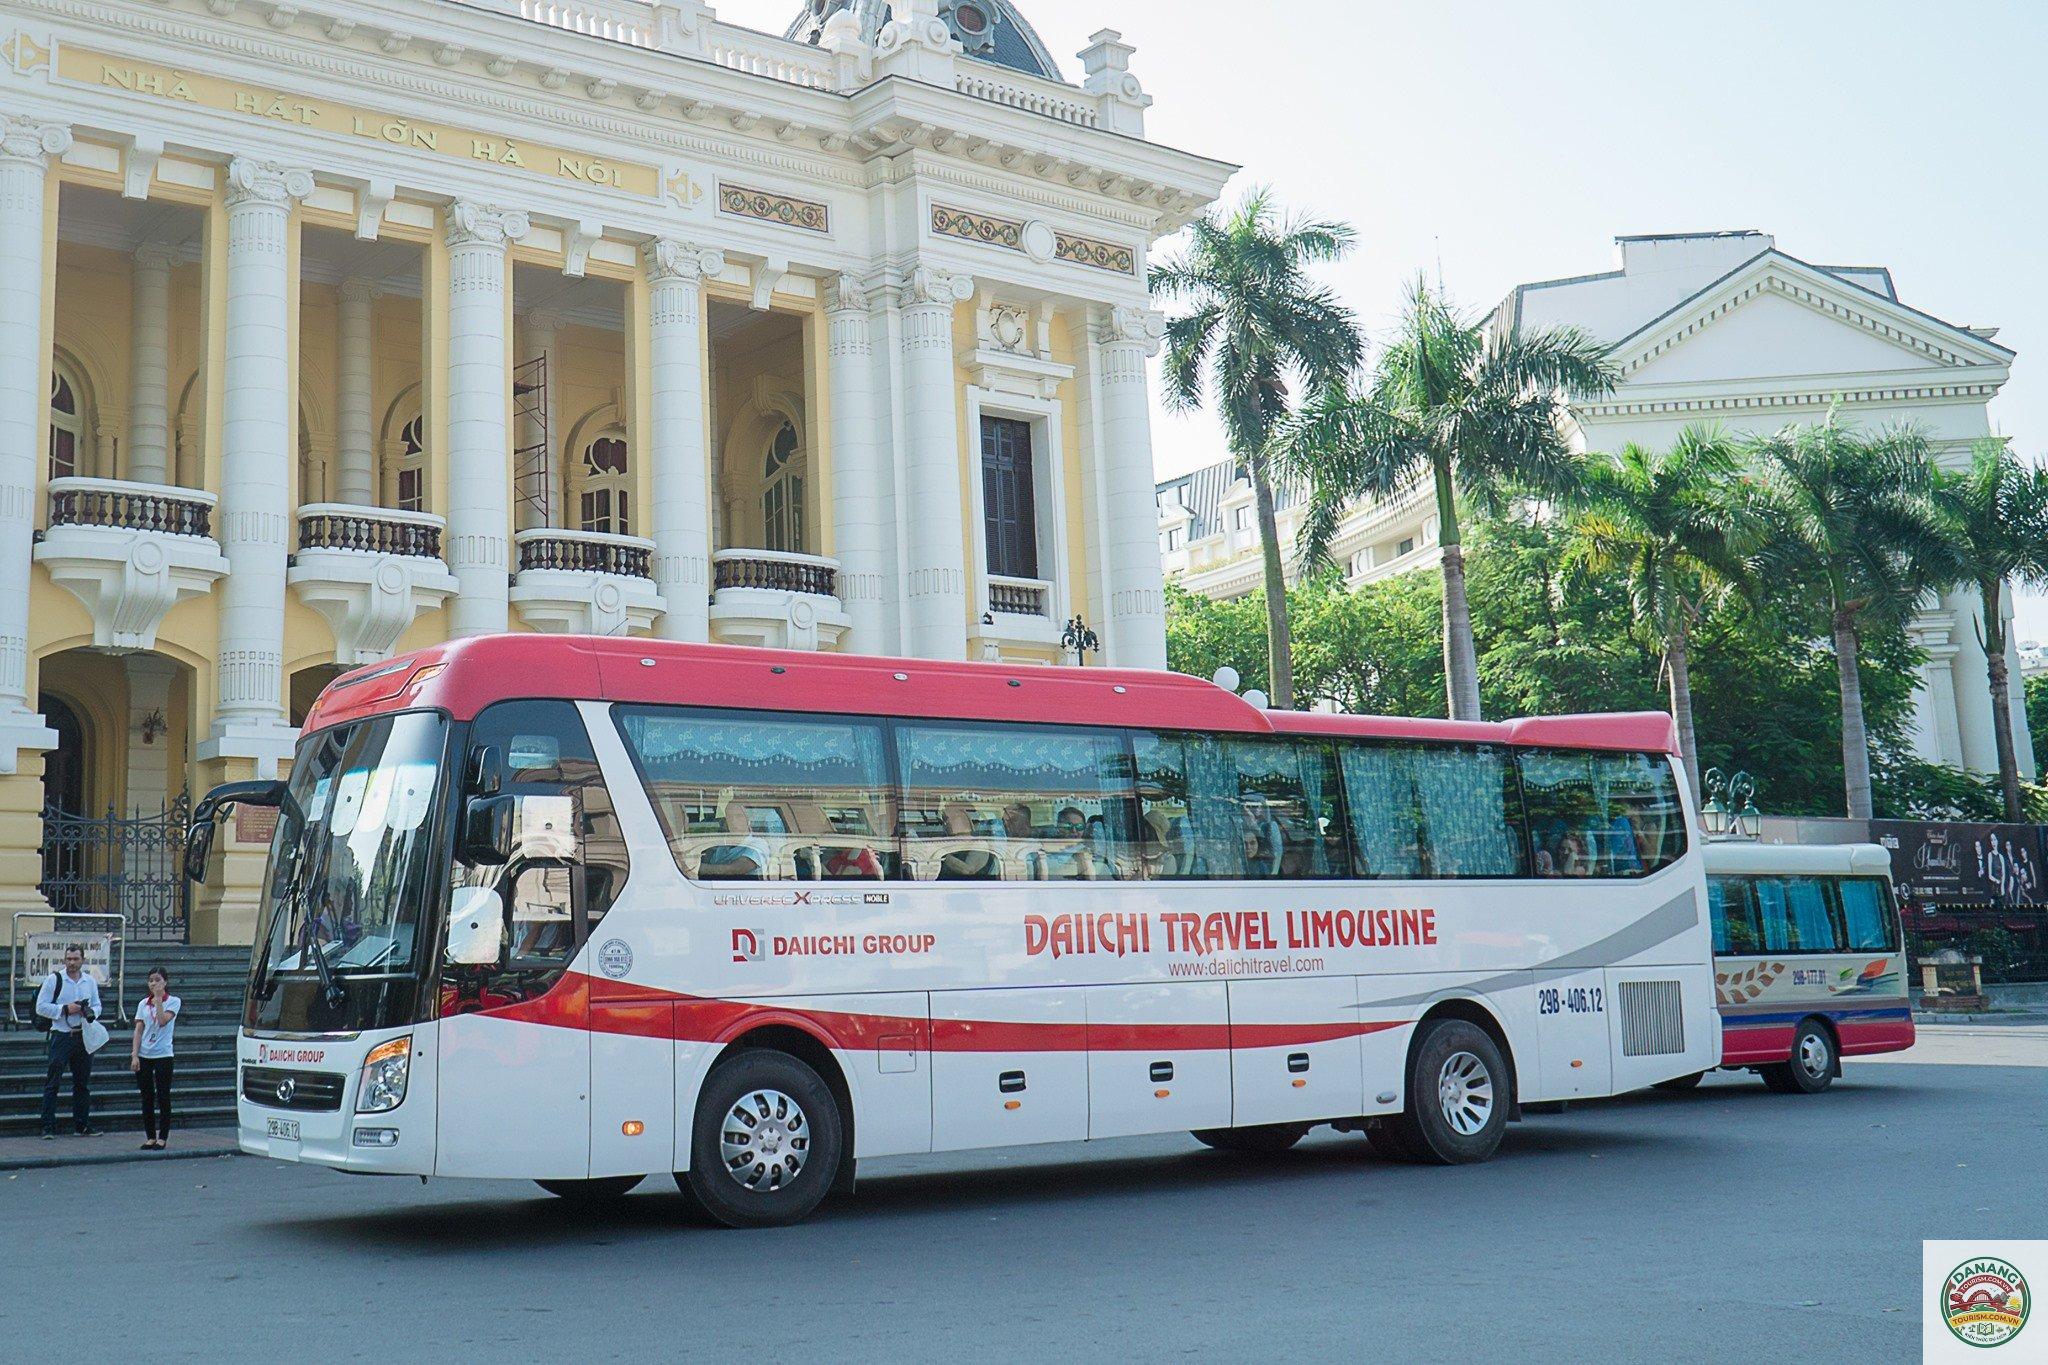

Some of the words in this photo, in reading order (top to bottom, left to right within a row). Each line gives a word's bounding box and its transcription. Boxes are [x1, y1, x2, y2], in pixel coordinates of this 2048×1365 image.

[100, 64, 198, 103] NHÀ
[234, 91, 320, 125] HÁT
[471, 139, 526, 168] HÀ
[557, 157, 623, 188] NỘI
[864, 893, 889, 904] NOBLE
[773, 936, 855, 956] DAIICHI
[862, 934, 936, 954] GROUP
[1024, 912, 1150, 960] DAIICHI
[1160, 911, 1277, 958] TRAVEL
[1286, 909, 1438, 948] LIMOUSINE
[269, 1049, 296, 1062] DAIICHI
[297, 1050, 325, 1063] GROUP
